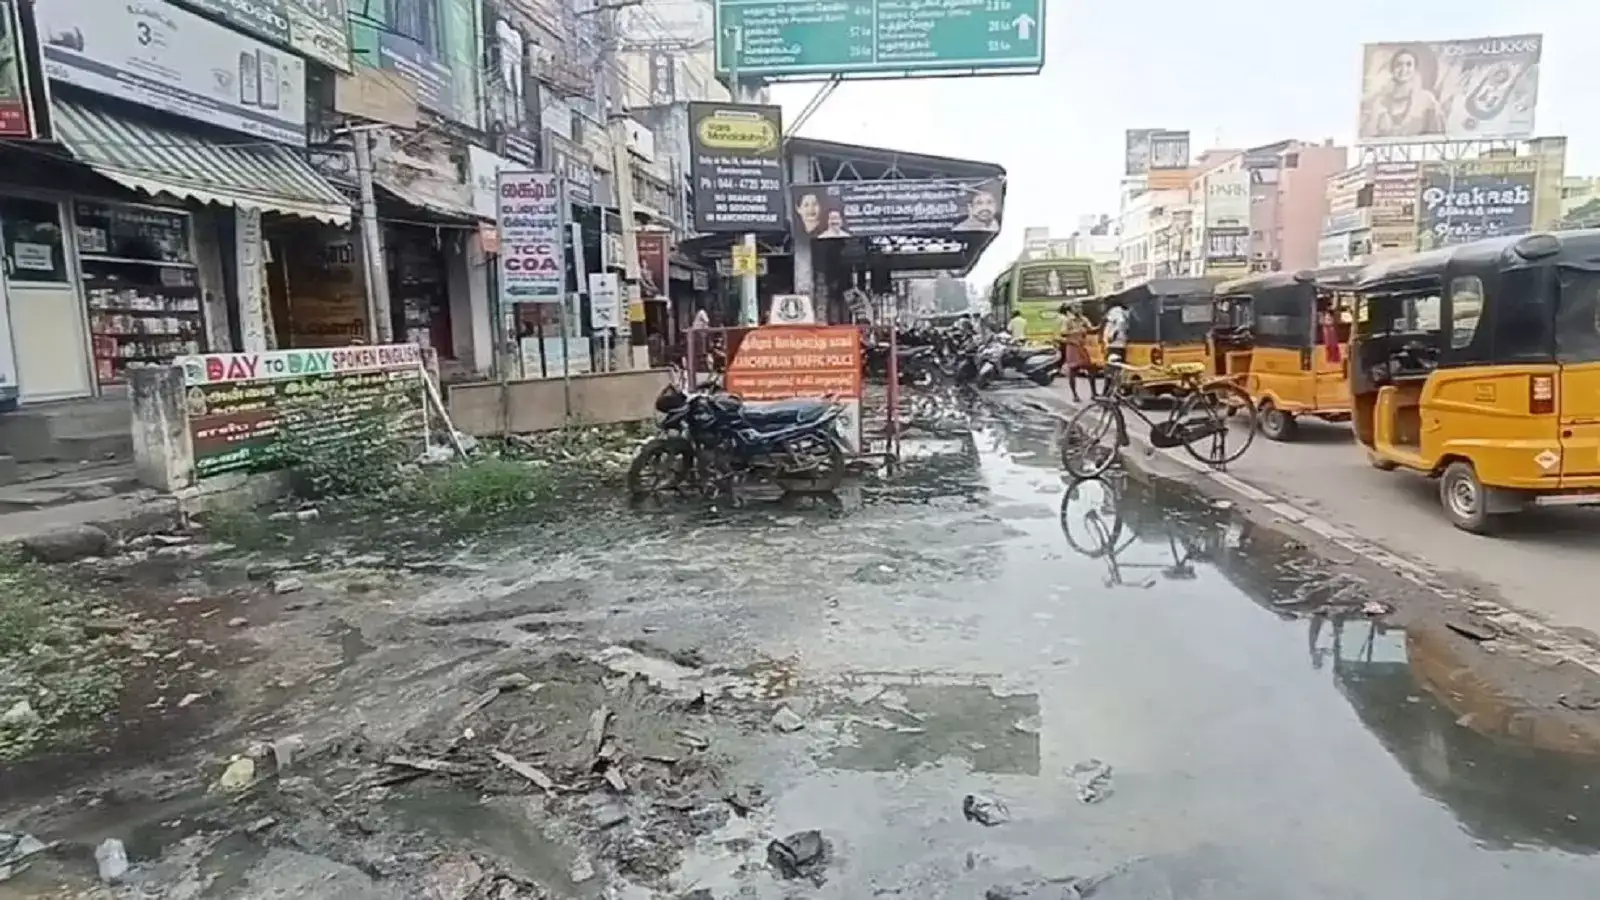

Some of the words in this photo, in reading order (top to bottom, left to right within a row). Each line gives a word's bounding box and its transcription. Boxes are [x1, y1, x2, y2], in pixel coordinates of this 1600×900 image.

[511, 245, 552, 255] TCC
[504, 257, 560, 271] COA
[206, 354, 260, 381] DAY
[264, 359, 284, 373] TO
[287, 352, 330, 374] DAY
[331, 349, 378, 370] SPOKEN
[379, 345, 420, 365] ENGLISH
[793, 353, 826, 368] TRAFFIC
[827, 353, 855, 367] POLICE
